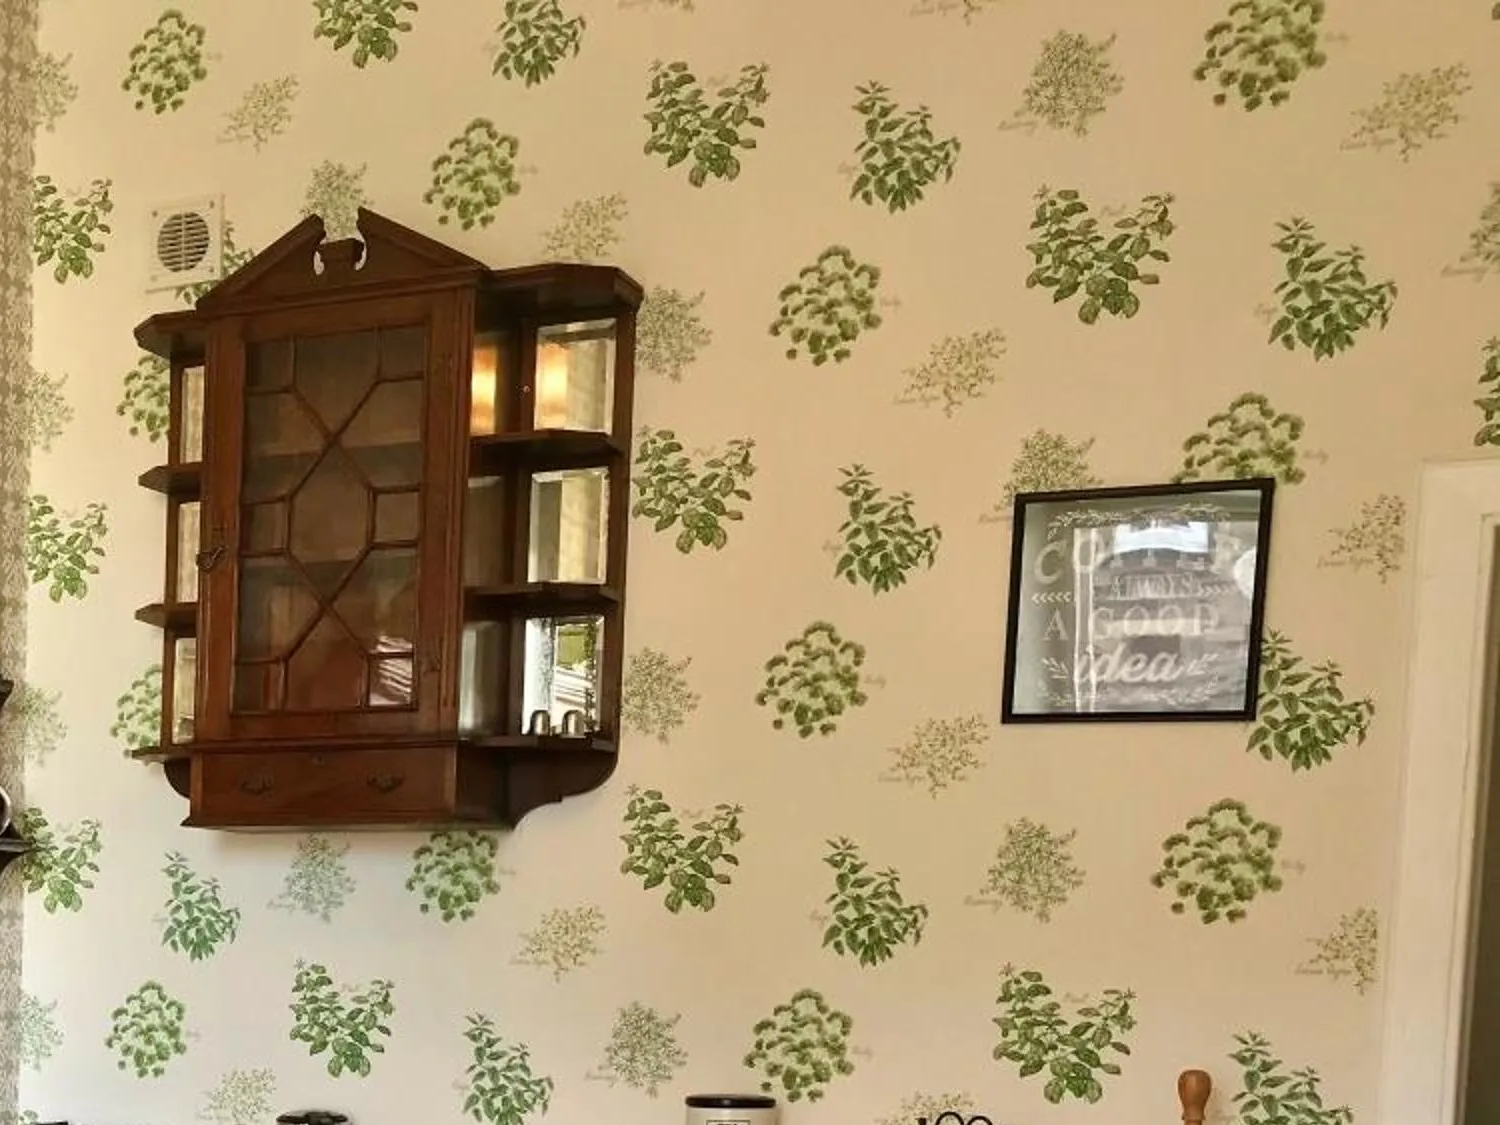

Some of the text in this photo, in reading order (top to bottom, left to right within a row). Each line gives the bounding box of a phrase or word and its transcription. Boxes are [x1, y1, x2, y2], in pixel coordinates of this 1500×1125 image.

[1044, 603, 1220, 641] A GOOD
[1076, 642, 1184, 683] idea
